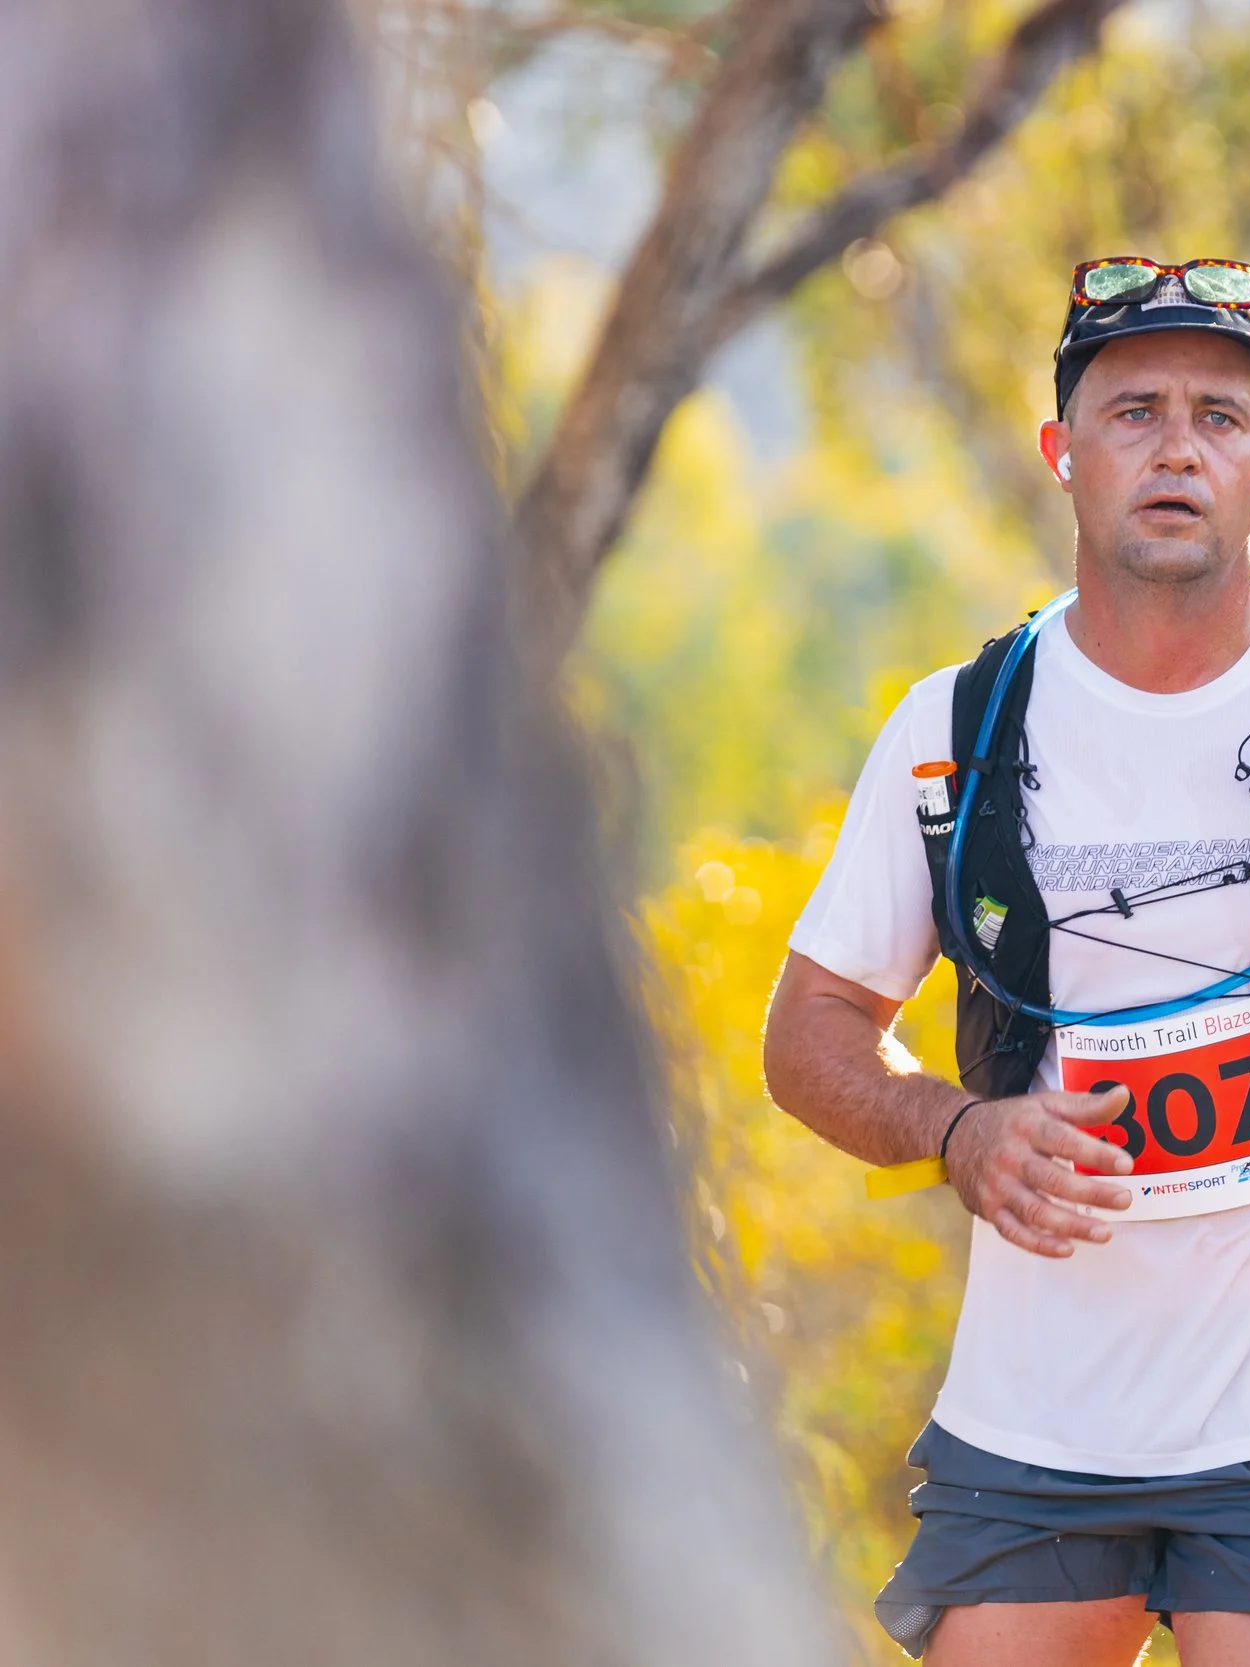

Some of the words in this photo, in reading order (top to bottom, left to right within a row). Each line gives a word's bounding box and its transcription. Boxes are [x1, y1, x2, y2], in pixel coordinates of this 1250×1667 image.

[1067, 1031, 1147, 1053] Tamworth
[1153, 1021, 1199, 1047] Trail
[1152, 1175, 1227, 1196] INTERSPORT
